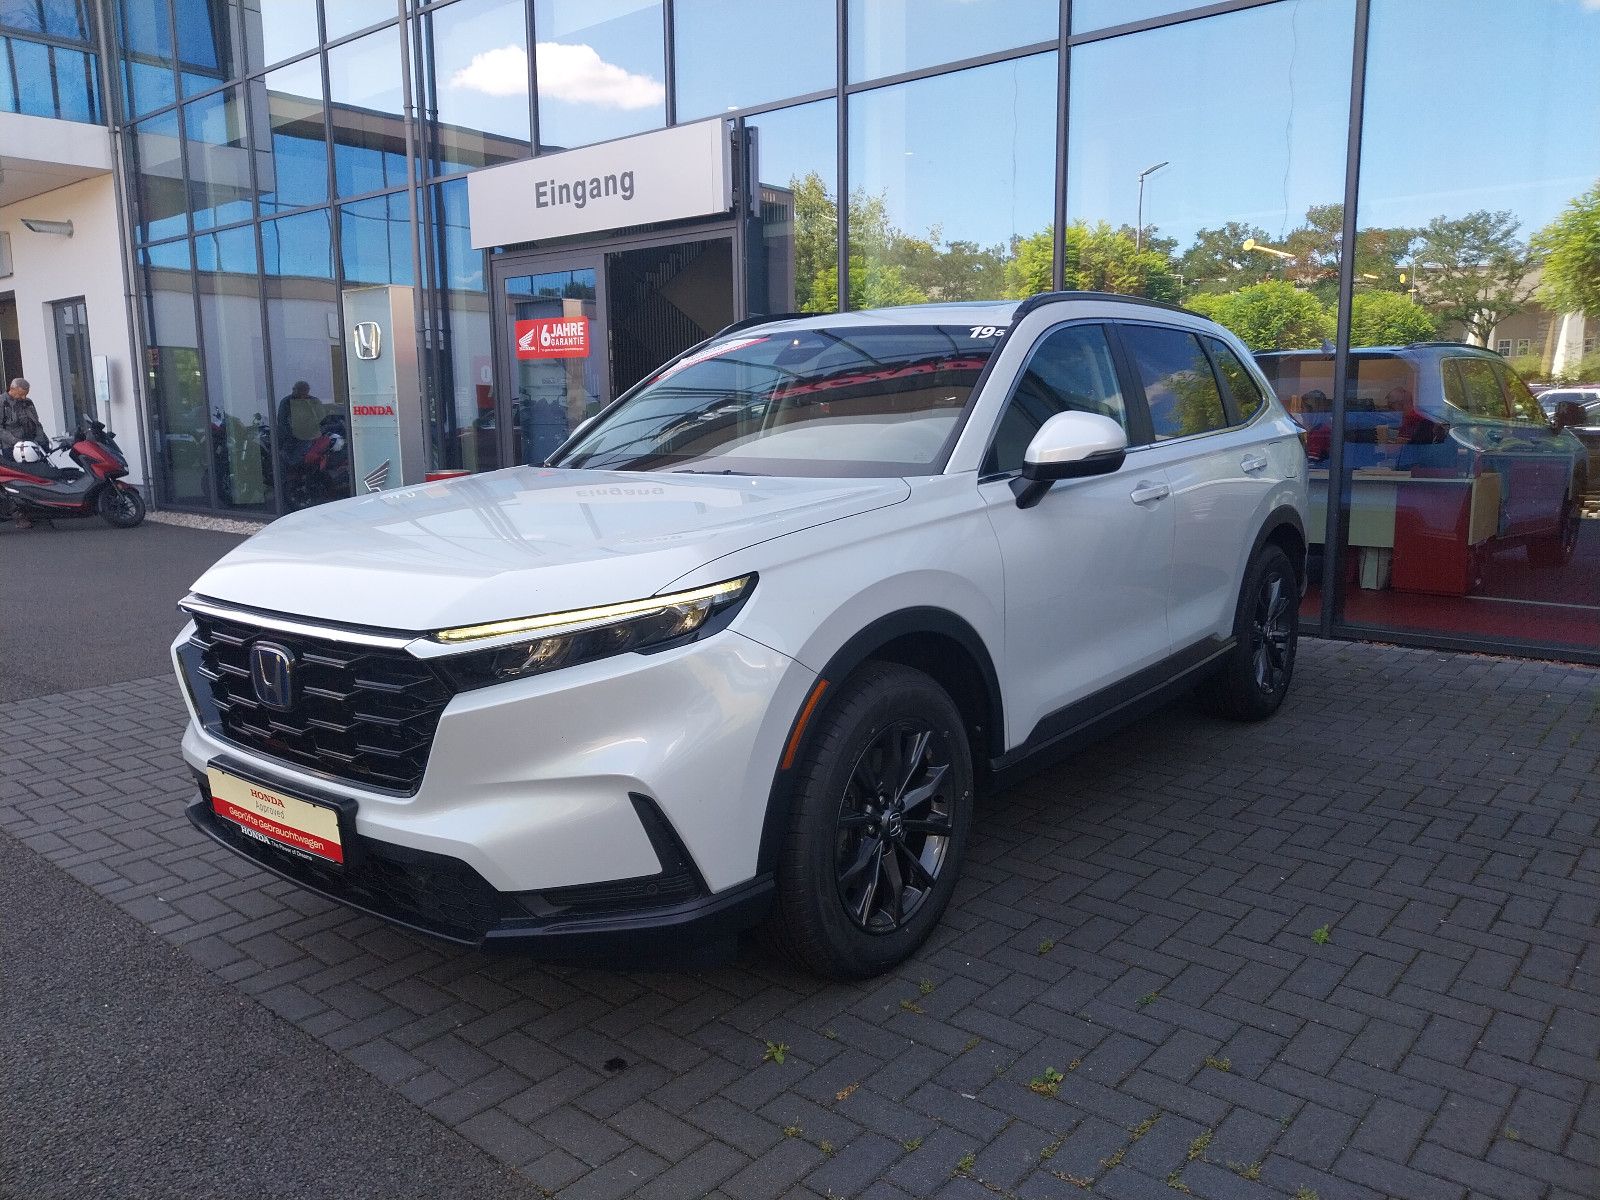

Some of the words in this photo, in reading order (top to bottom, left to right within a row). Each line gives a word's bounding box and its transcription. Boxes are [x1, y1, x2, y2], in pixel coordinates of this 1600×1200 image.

[535, 171, 634, 209] Eingang
[541, 324, 551, 346] 6
[550, 337, 584, 346] GARANTIE
[970, 326, 1006, 339] 195
[353, 406, 394, 416] HONDA
[250, 789, 285, 808] HONDA
[255, 800, 285, 819] Approved
[228, 806, 258, 826] Geprüfte
[258, 819, 325, 851] Gebrauchtwagen
[240, 825, 270, 844] HONDA
